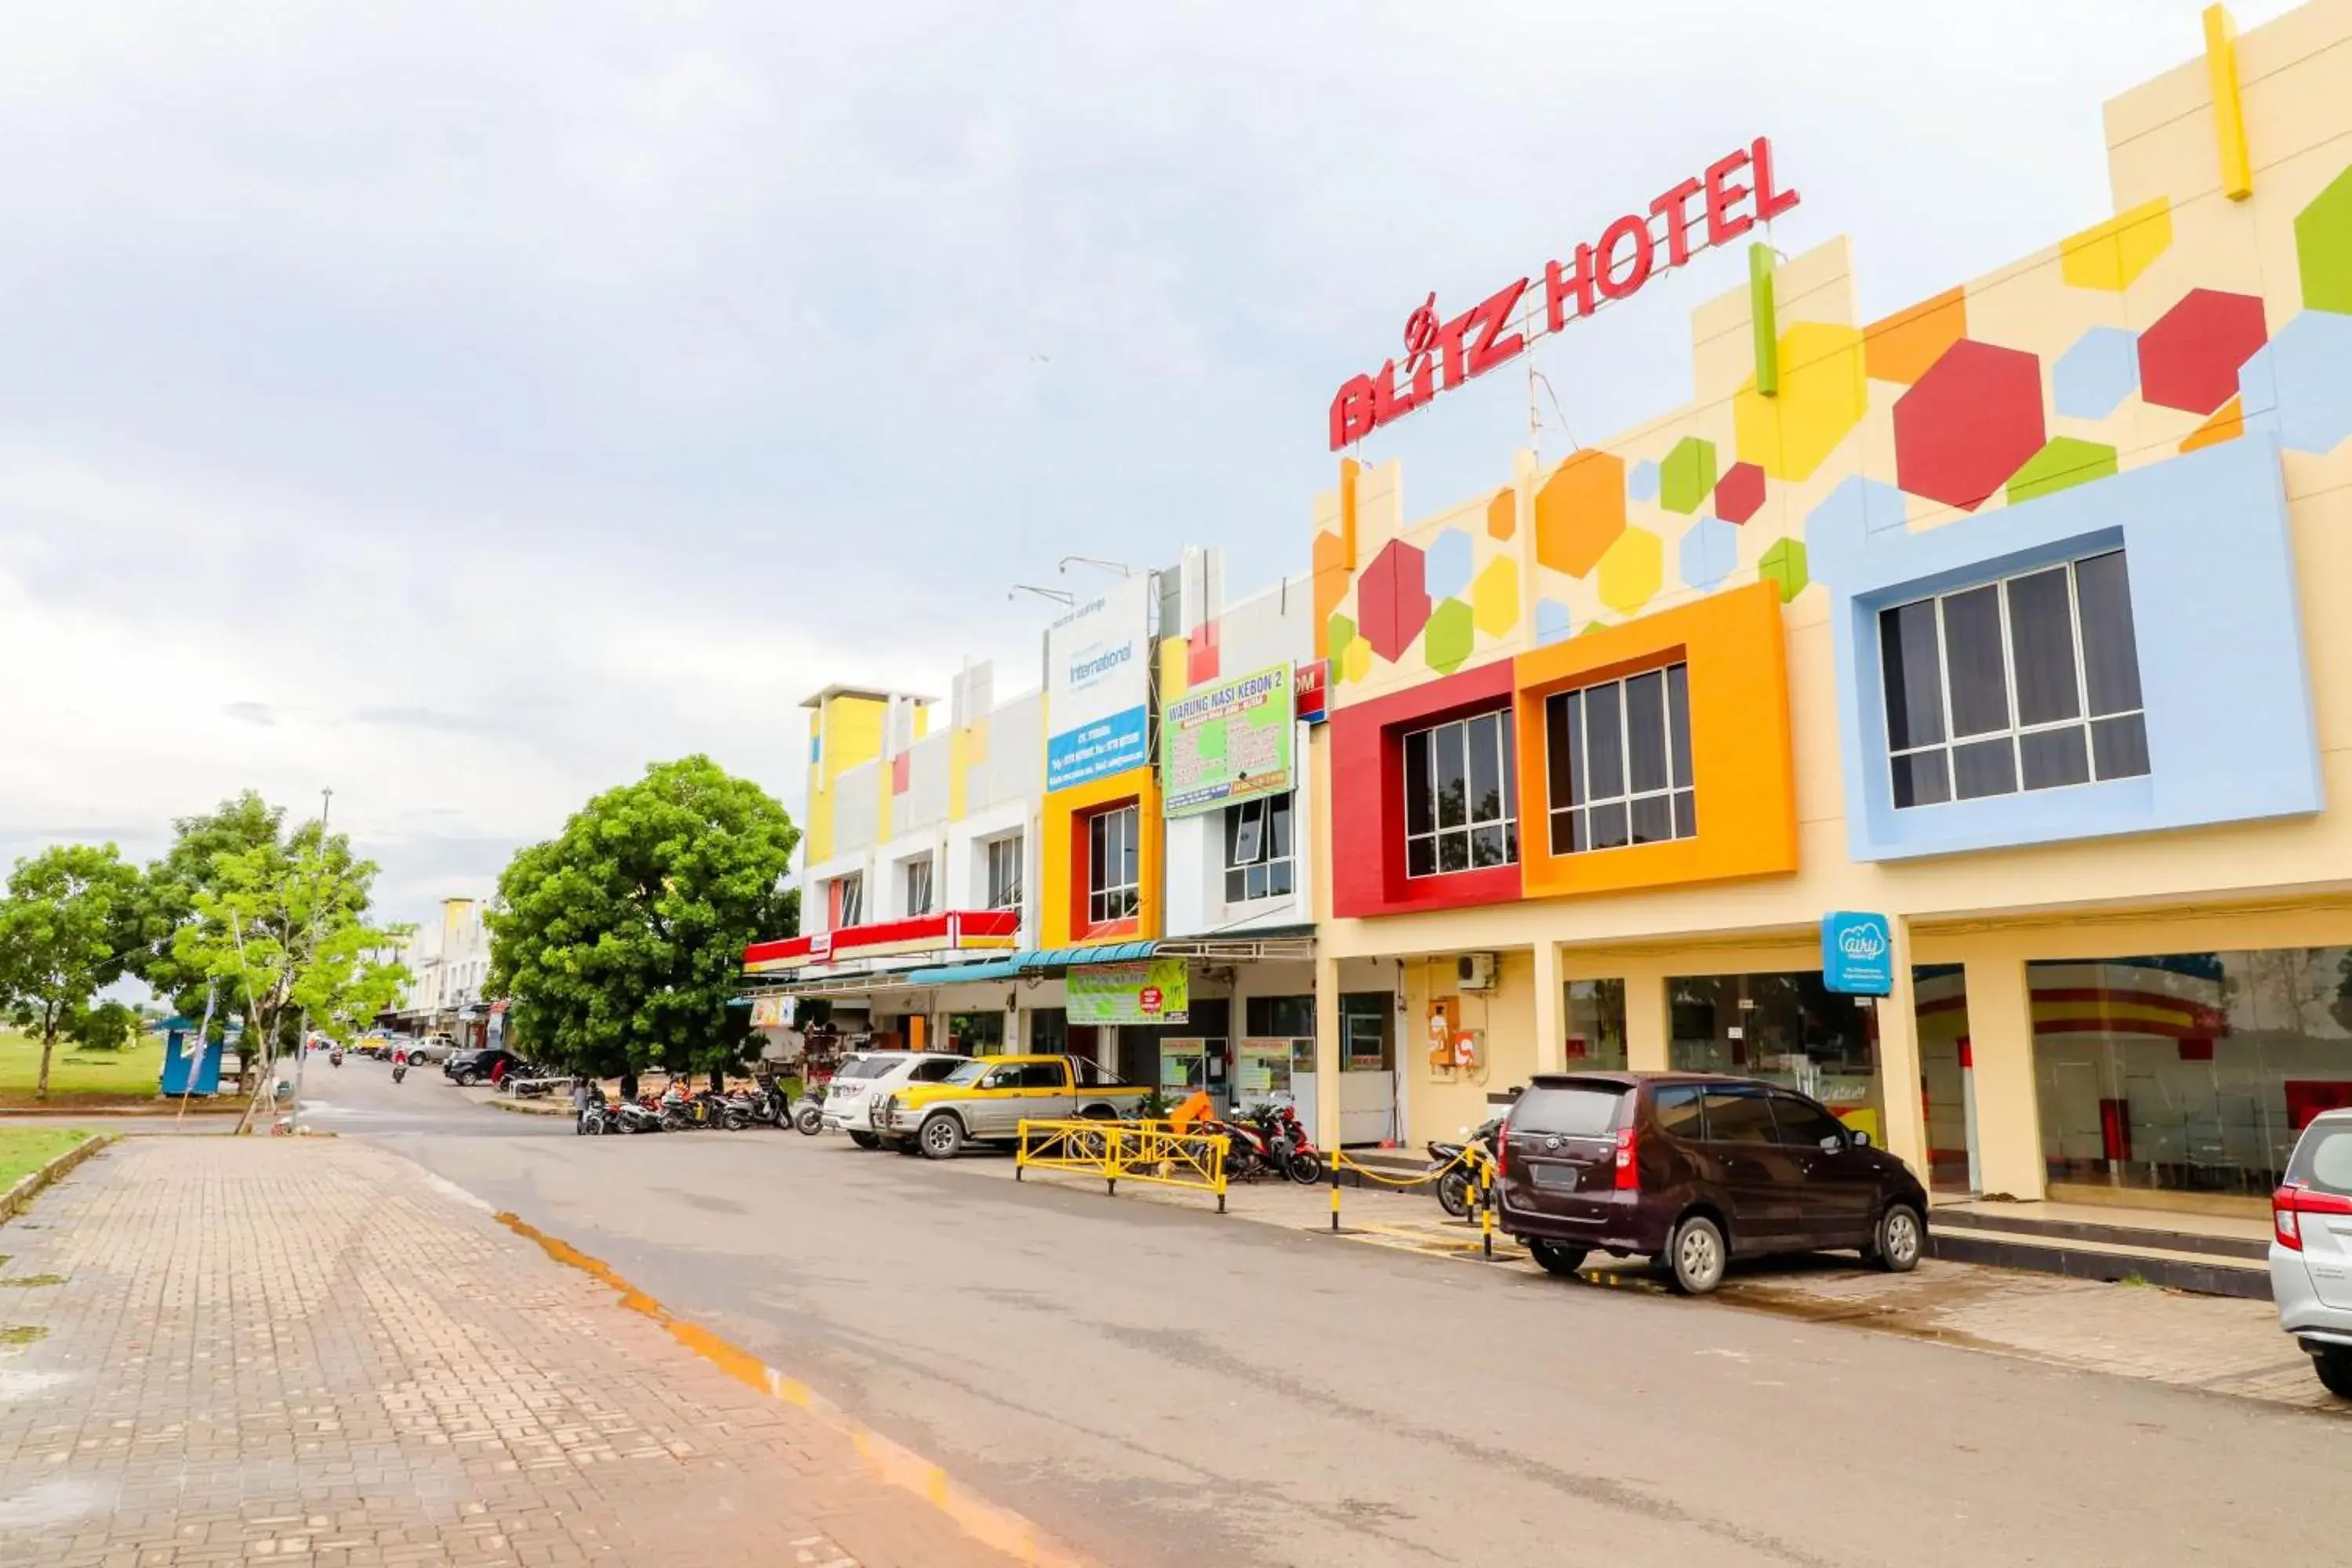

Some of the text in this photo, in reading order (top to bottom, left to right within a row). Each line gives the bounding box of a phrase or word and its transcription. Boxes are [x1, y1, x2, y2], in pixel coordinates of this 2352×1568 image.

[1330, 136, 1800, 451] BLITZ HOTEL
[1070, 639, 1131, 683] International
[1169, 695, 1208, 722] WARUNG
[1212, 688, 1235, 706] NASI
[1238, 673, 1272, 699] KEBON
[1276, 670, 1282, 688] 2
[1845, 931, 1878, 960] airy
